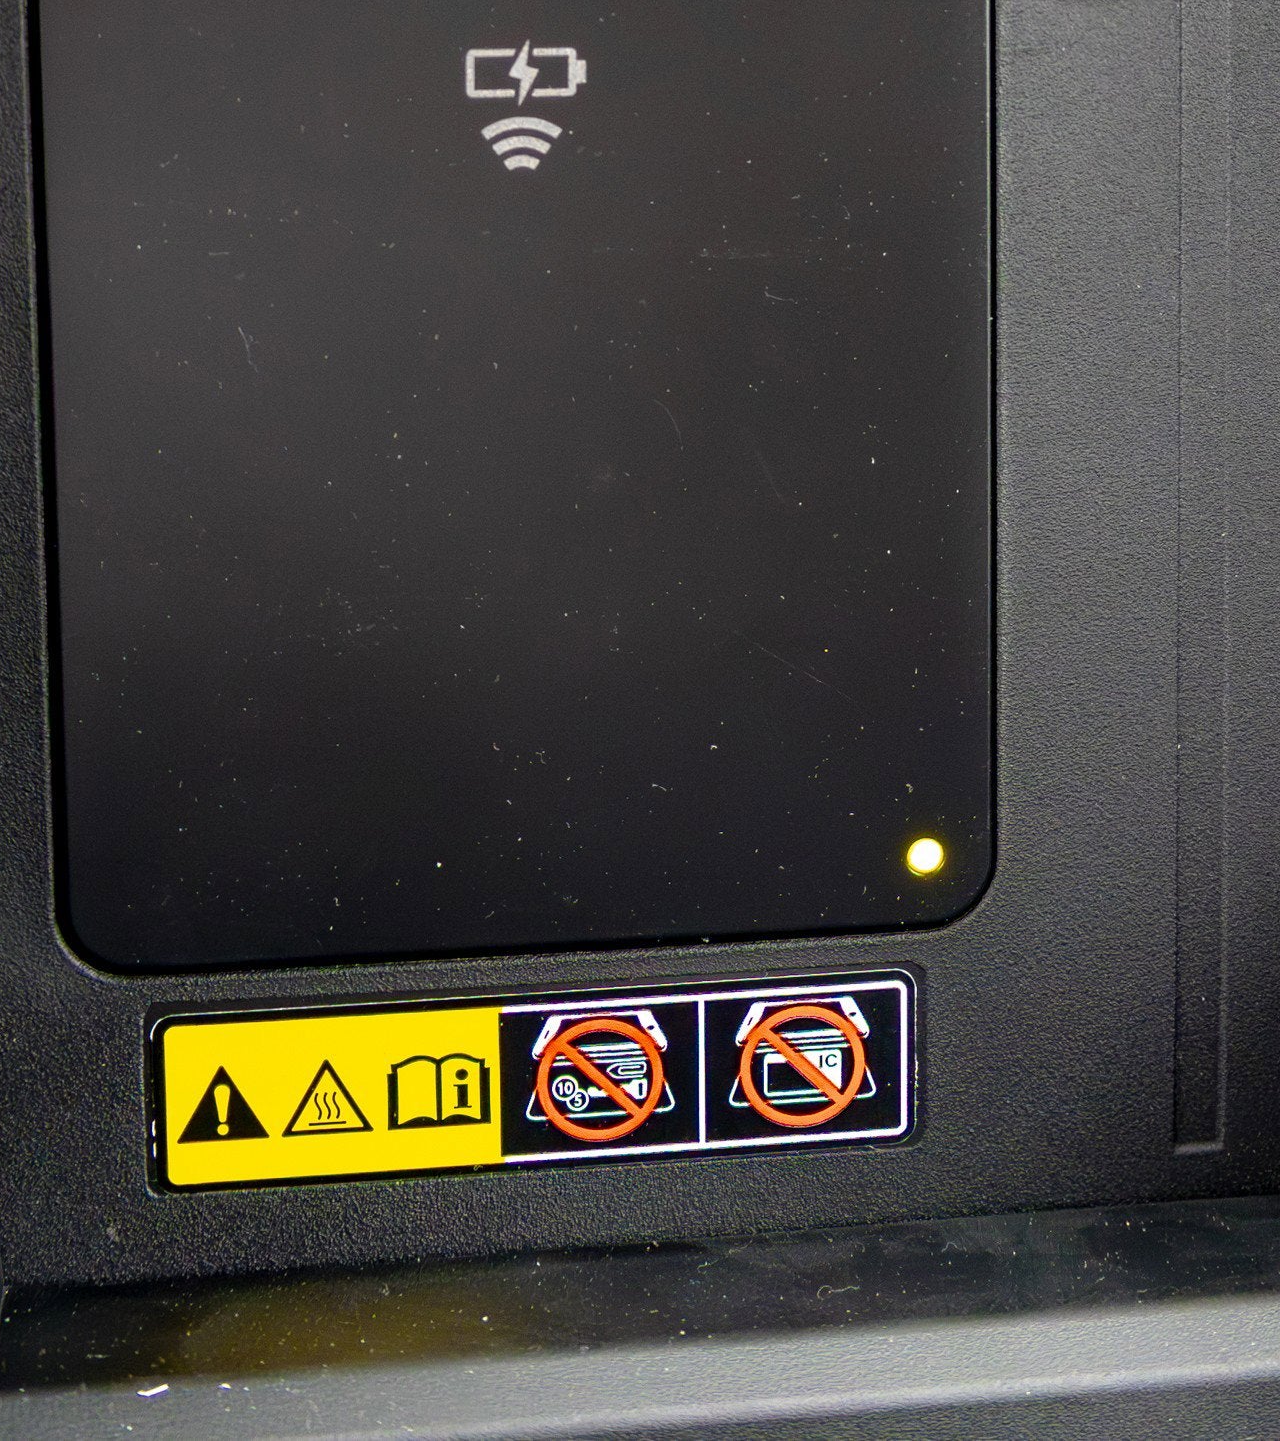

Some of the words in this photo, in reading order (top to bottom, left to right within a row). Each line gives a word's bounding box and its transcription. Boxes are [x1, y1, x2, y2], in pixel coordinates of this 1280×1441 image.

[819, 1053, 838, 1068] IC
[557, 1081, 575, 1096] 10
[574, 1093, 582, 1107] 5
